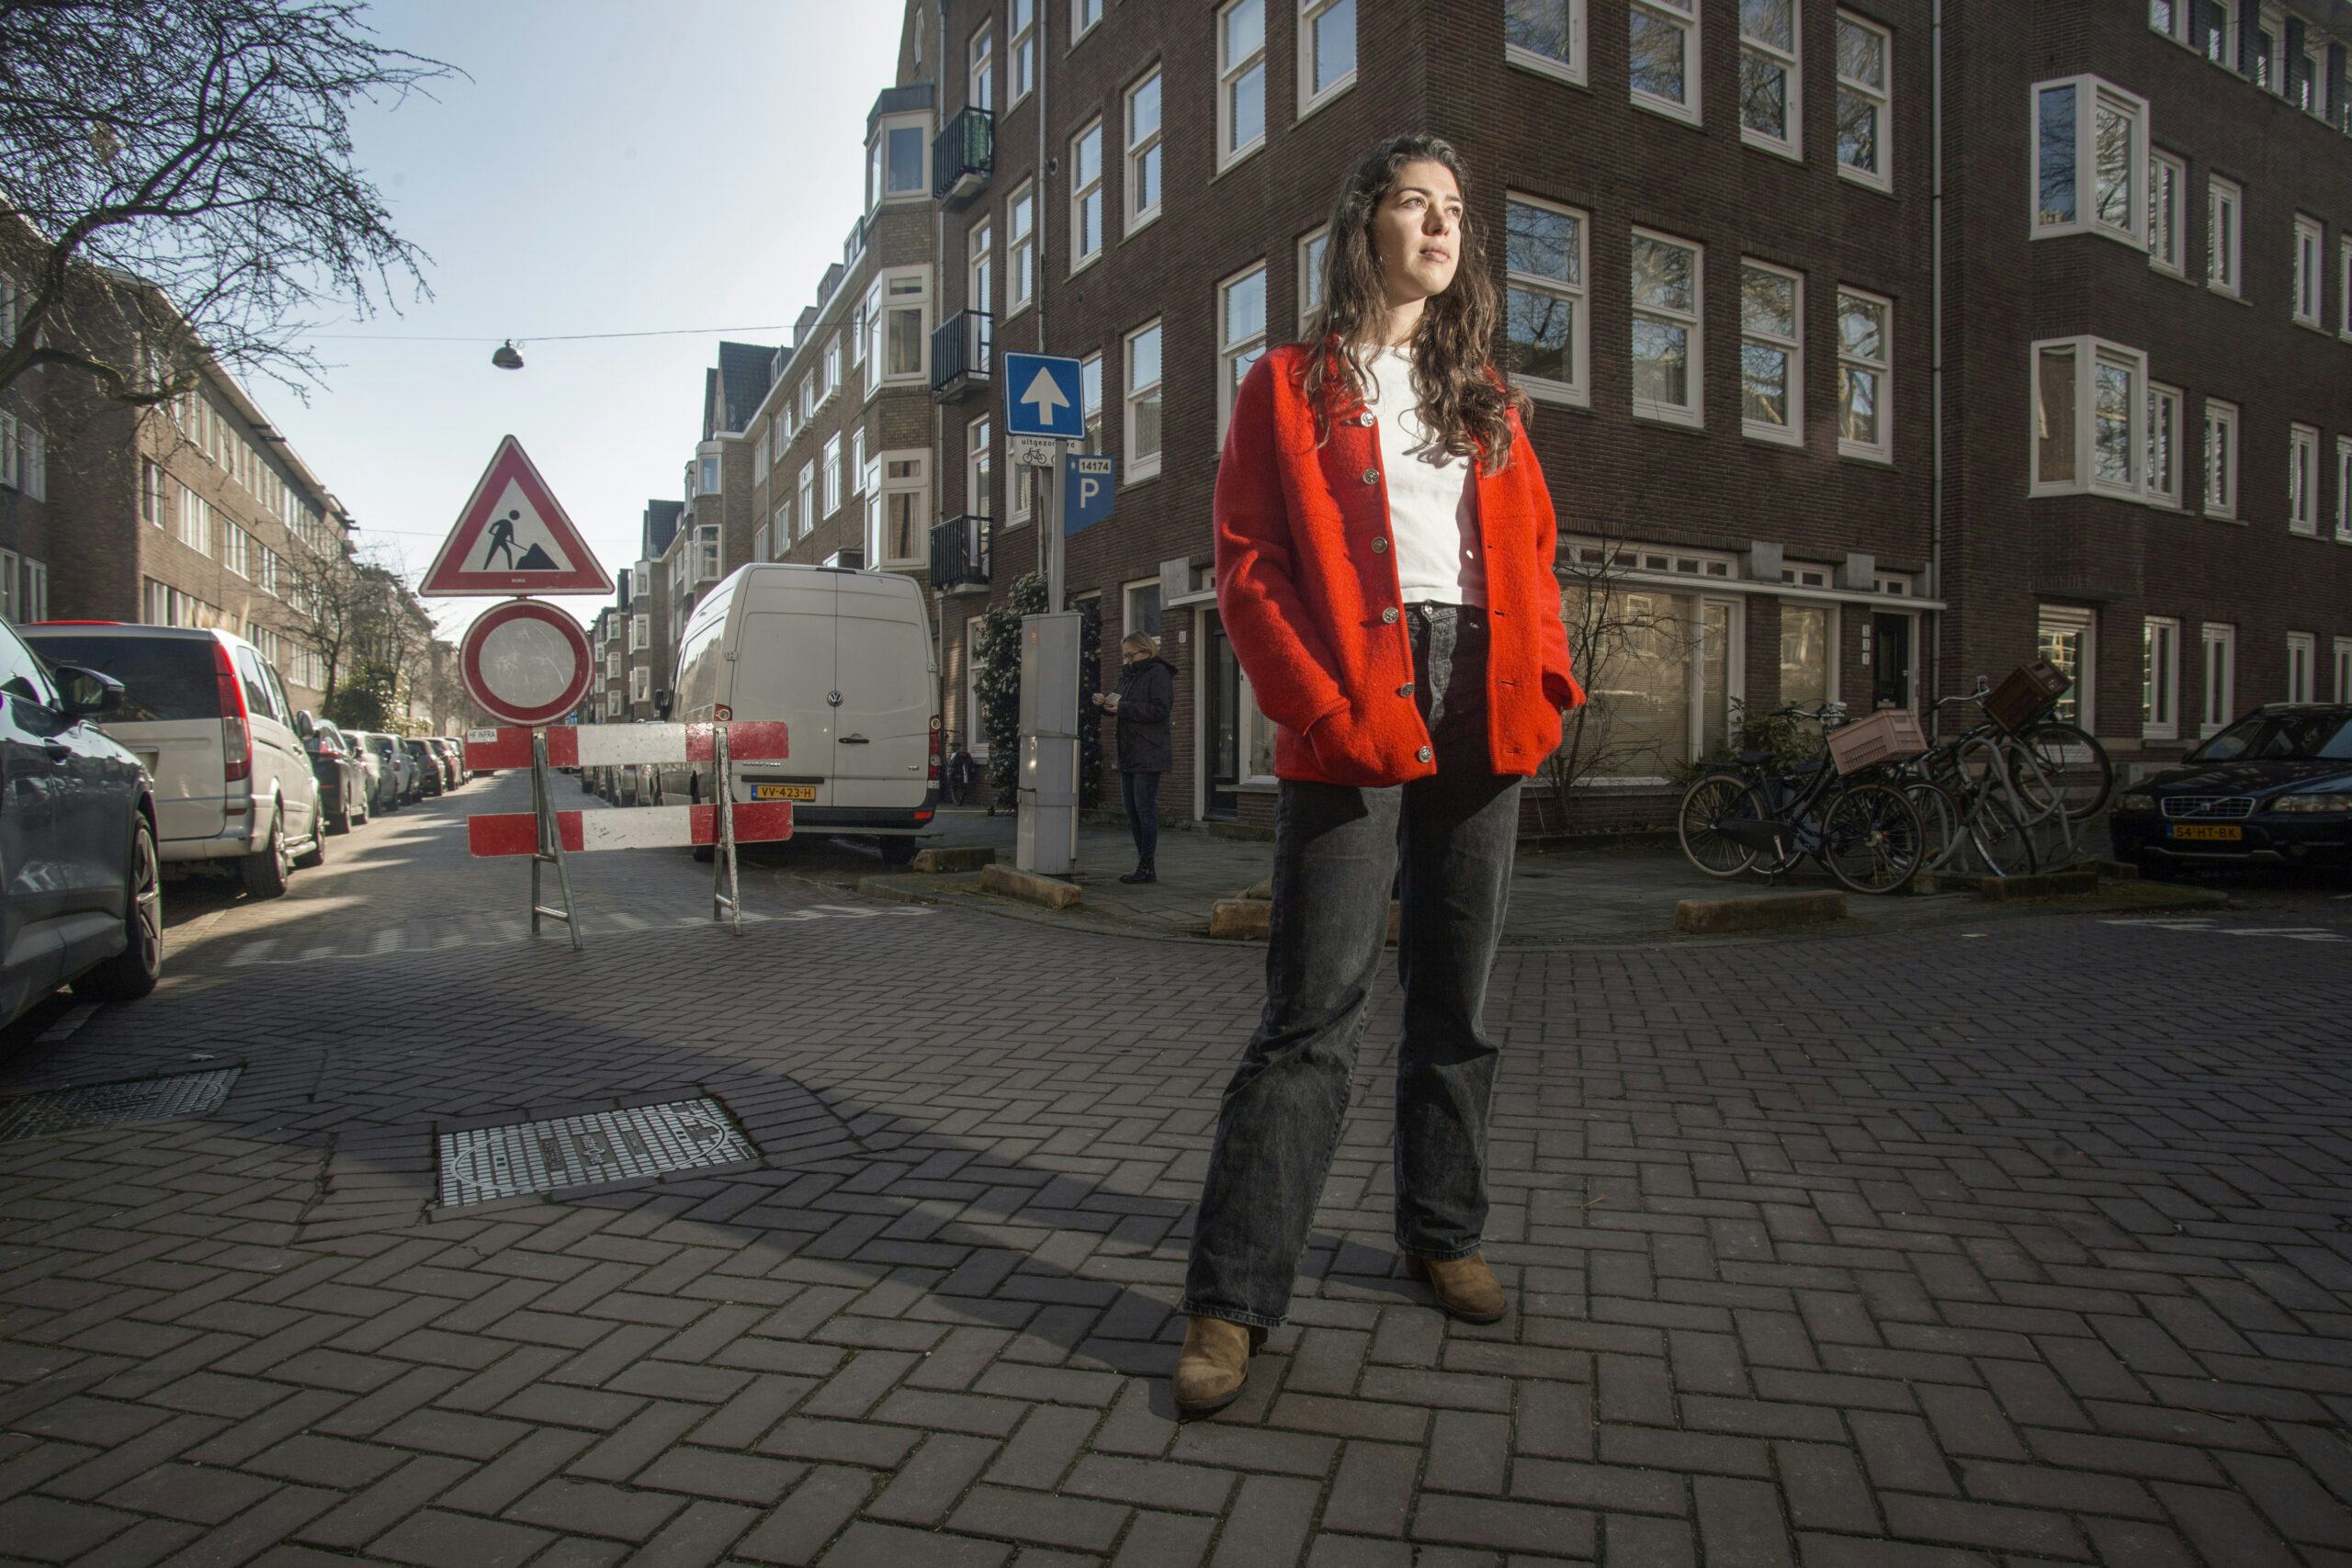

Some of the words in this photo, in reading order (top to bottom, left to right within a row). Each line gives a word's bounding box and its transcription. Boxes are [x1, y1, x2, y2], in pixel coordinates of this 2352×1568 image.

[1080, 461, 1109, 471] 14174
[1080, 478, 1100, 508] P
[762, 787, 811, 797] VV-423-H
[2176, 827, 2237, 838] 54-HT-BK
